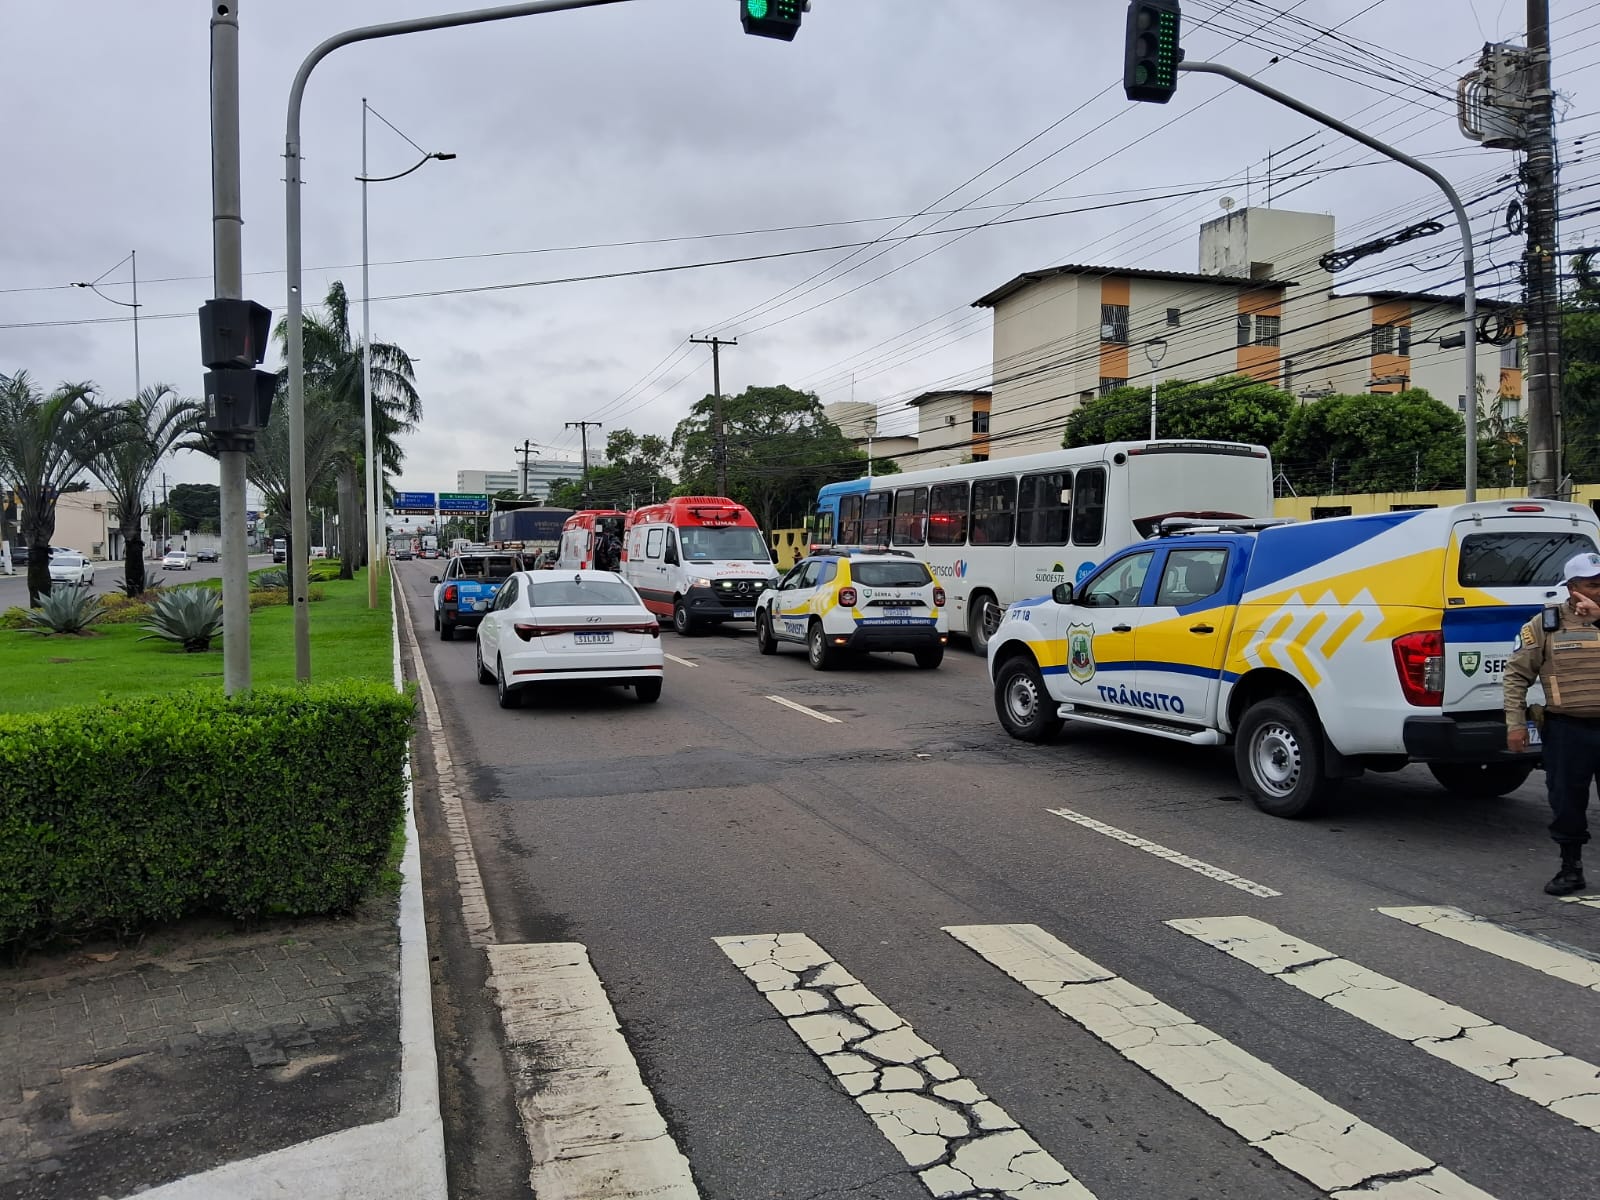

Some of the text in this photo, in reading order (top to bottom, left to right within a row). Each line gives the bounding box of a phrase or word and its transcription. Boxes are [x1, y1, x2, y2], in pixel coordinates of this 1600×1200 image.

[1035, 573, 1065, 583] SUDOESTE
[1011, 608, 1031, 621] PT 18
[1484, 659, 1507, 674] SER
[1097, 683, 1185, 714] TRÂNSITO
